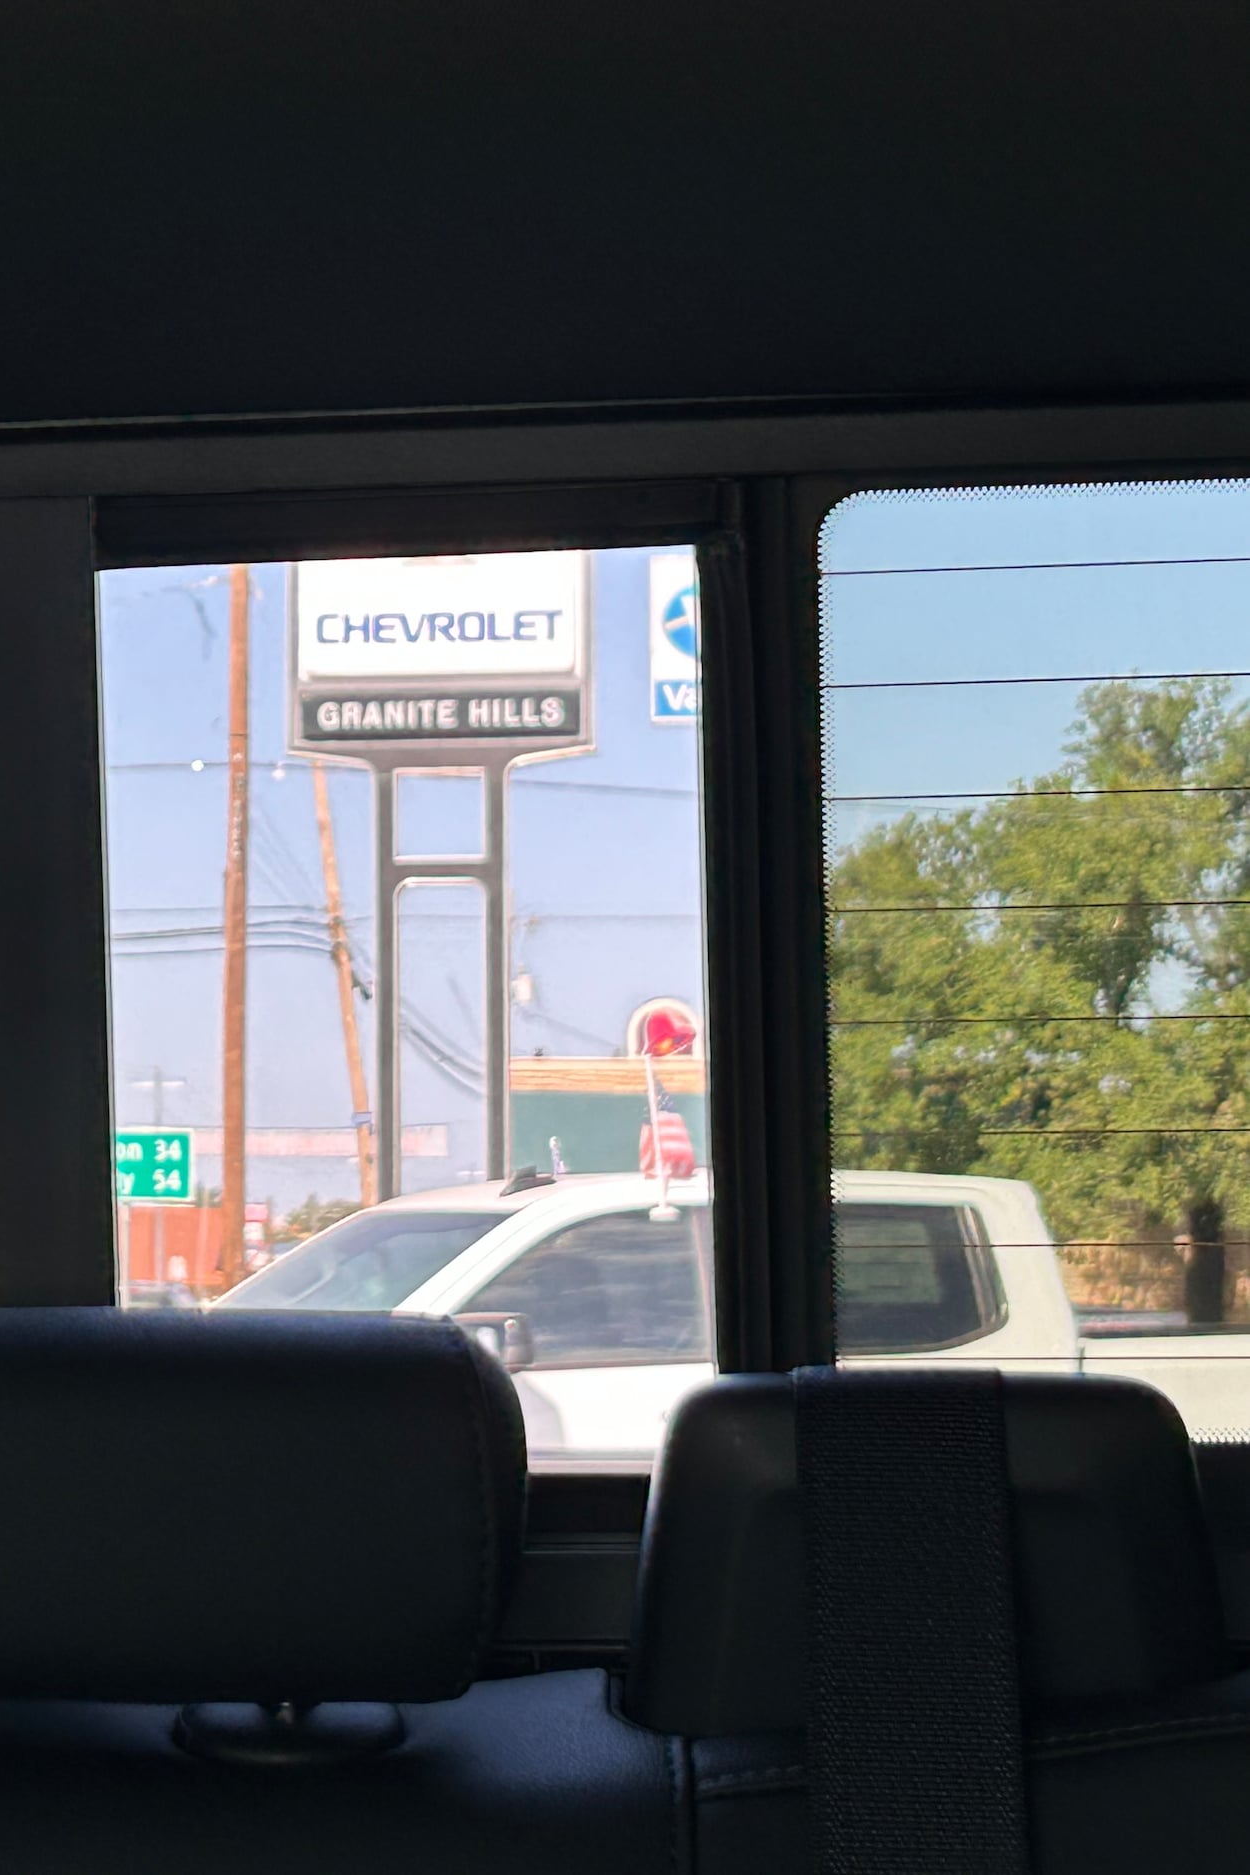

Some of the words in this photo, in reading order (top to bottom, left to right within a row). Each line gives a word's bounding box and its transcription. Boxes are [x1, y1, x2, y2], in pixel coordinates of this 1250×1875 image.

[316, 609, 563, 644] CHEVROLET
[317, 701, 458, 732] GRANITE
[468, 697, 565, 729] HILLS
[153, 1138, 183, 1163] 34
[152, 1167, 183, 1194] 54
